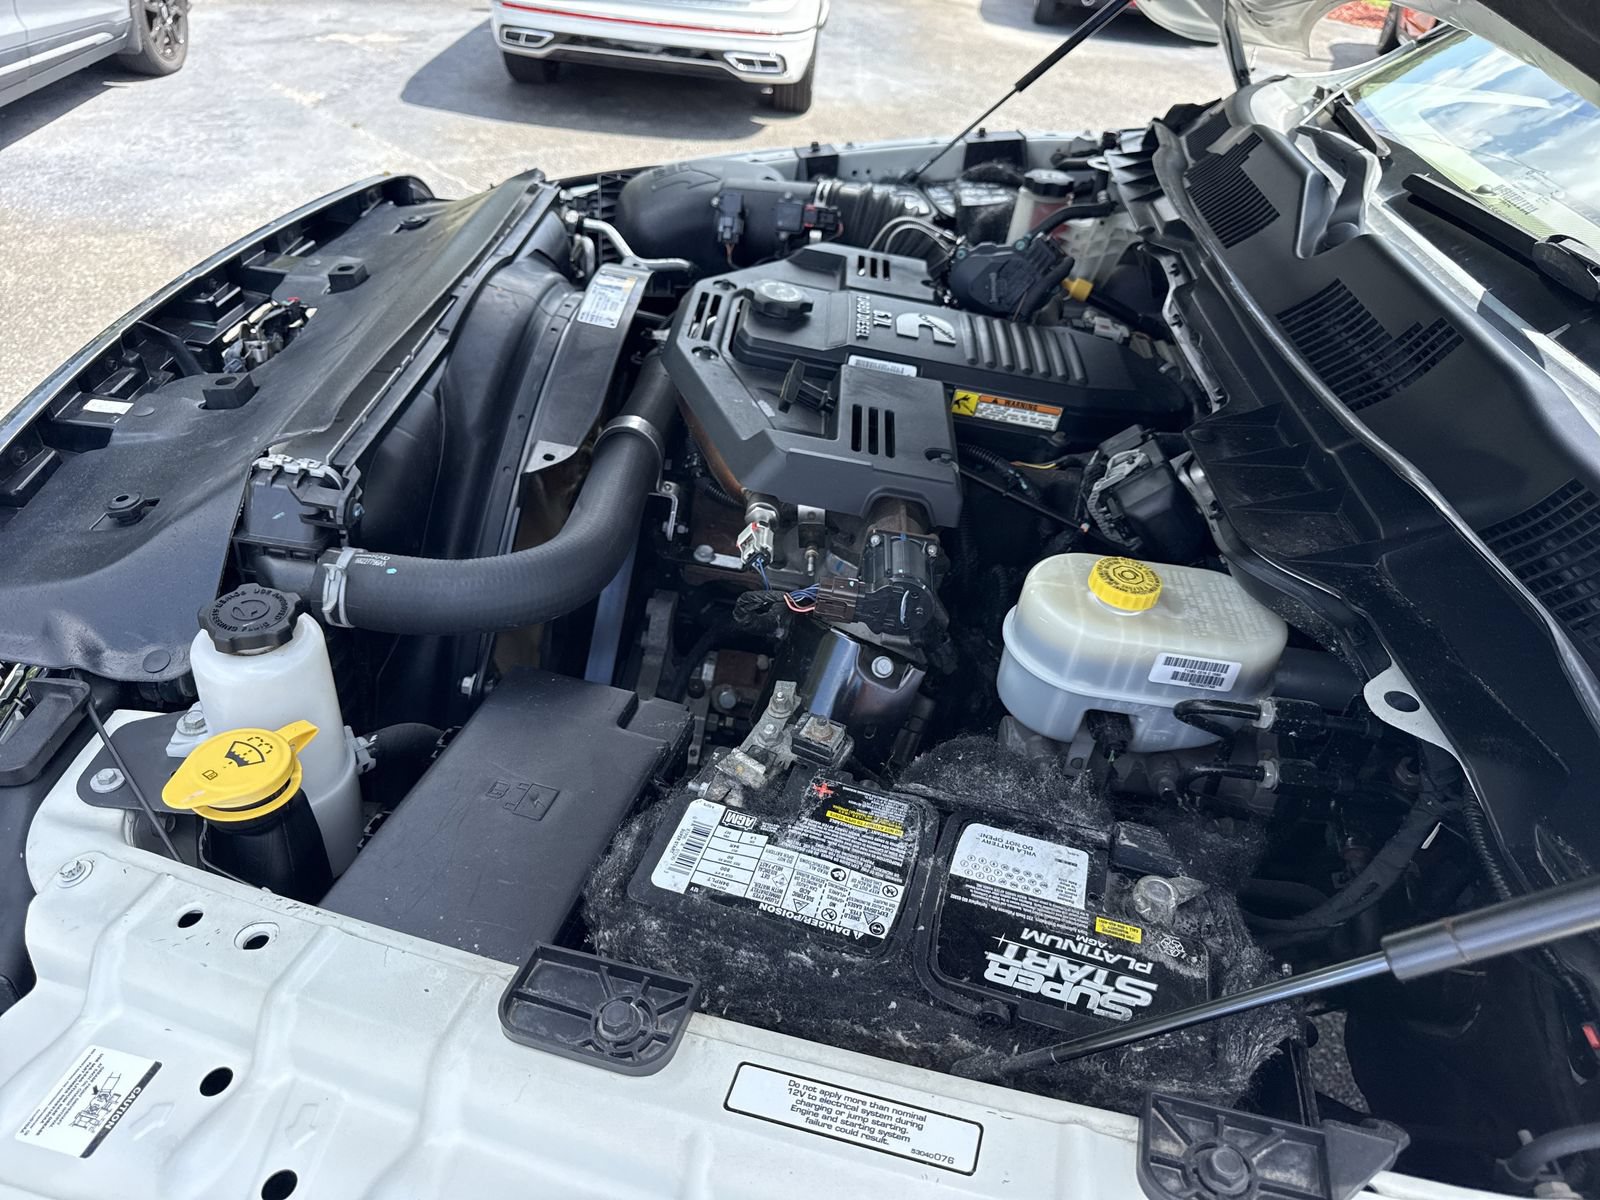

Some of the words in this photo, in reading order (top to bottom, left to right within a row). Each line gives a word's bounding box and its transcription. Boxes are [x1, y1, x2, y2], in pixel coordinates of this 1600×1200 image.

[724, 812, 754, 827] AGM
[980, 838, 1014, 850] BATTERY
[1005, 839, 1020, 847] NOT
[1015, 848, 1036, 856] VRLA
[758, 902, 855, 936] DANGER/POISON
[1019, 926, 1153, 974] PLATINUM
[1075, 934, 1106, 949] AGM
[983, 959, 1133, 1022] SUPER
[985, 941, 1158, 1007] START
[105, 1086, 142, 1130] CAUTION
[788, 1079, 800, 1088] Do
[802, 1084, 816, 1092] not
[819, 1088, 841, 1100] apply
[844, 1095, 866, 1106] more
[869, 1101, 889, 1111] than
[892, 1107, 926, 1121] nominal
[788, 1087, 805, 1098] 12V
[819, 1095, 858, 1112] electrical
[860, 1108, 892, 1122] system
[894, 1116, 923, 1131] during
[795, 1098, 832, 1114] charging
[835, 1109, 844, 1117] or
[846, 1112, 868, 1124] jump
[871, 1118, 908, 1134] starting.
[790, 1104, 819, 1119] Engine
[822, 1113, 837, 1122] and
[840, 1118, 875, 1134] starting
[877, 1129, 910, 1144] system
[805, 1116, 832, 1129] failure
[835, 1124, 858, 1136] could
[860, 1131, 889, 1145] result.
